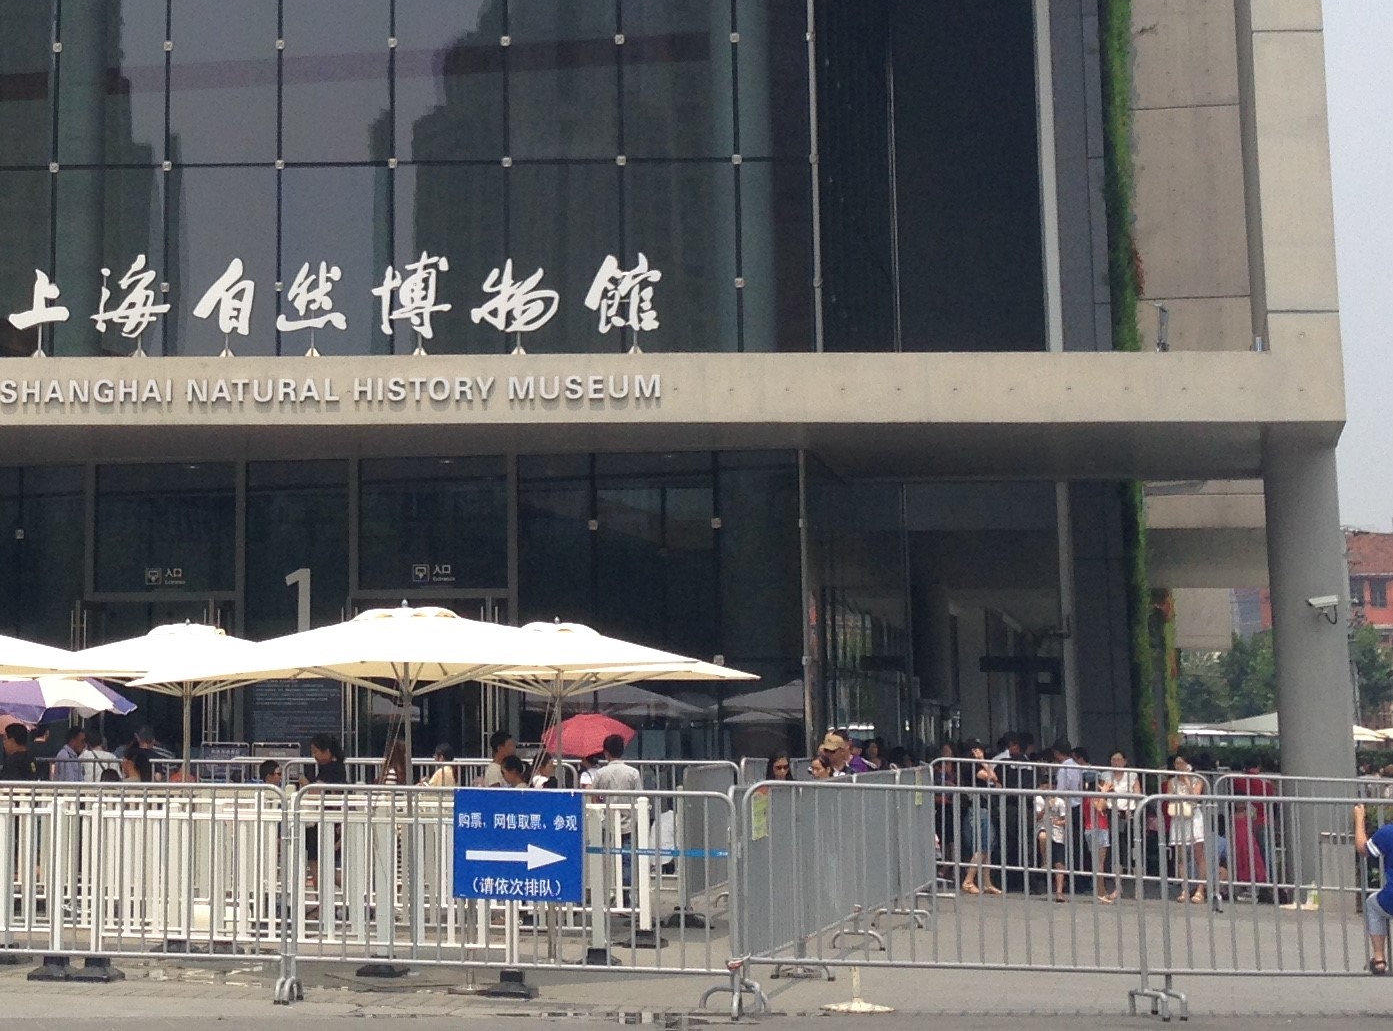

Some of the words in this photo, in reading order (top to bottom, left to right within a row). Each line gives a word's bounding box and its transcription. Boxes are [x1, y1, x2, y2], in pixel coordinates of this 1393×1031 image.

[0, 379, 174, 404] SHANGHAI
[186, 378, 340, 402] NATURAL
[353, 376, 495, 401] HISTORY
[508, 374, 662, 400] MUSEUM
[285, 568, 311, 633] 1
